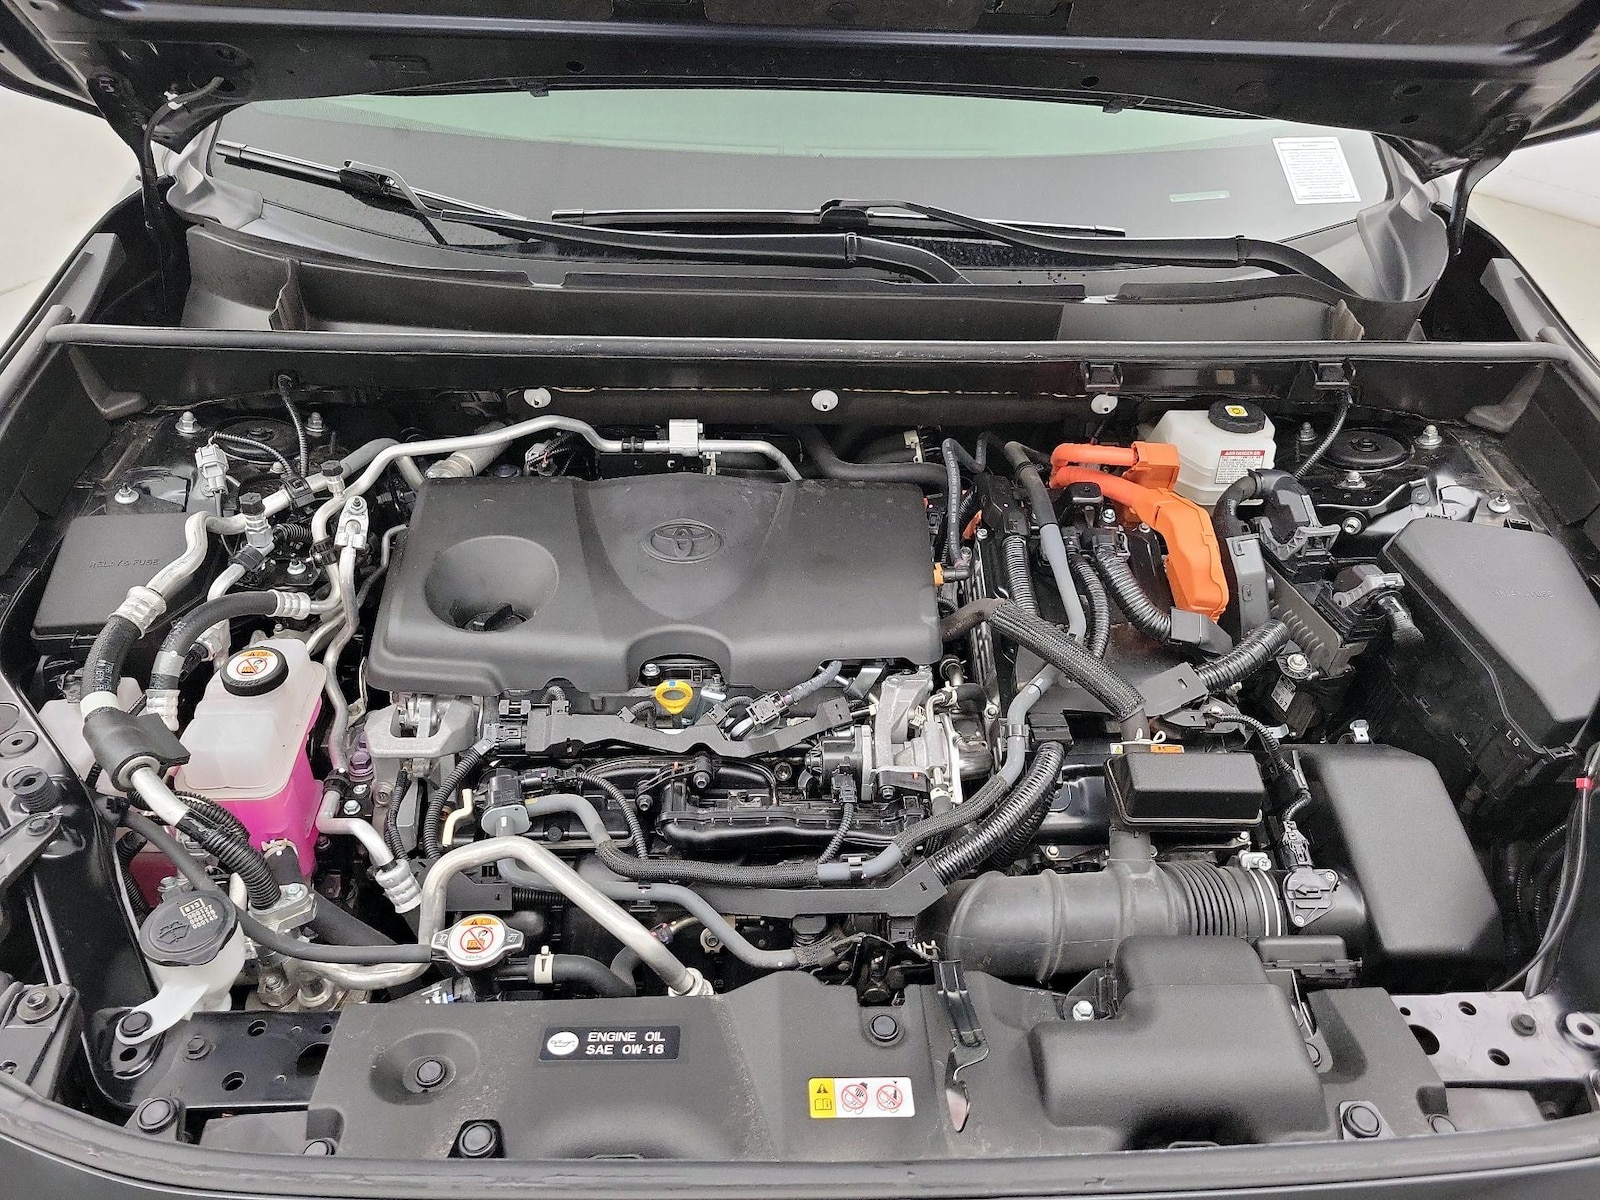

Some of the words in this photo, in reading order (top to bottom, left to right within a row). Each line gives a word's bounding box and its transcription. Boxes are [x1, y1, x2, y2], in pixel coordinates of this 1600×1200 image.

[587, 1031, 637, 1042] ENGINE
[644, 1031, 666, 1042] OIL
[585, 1044, 614, 1055] SAE
[622, 1043, 665, 1055] 0W-16
